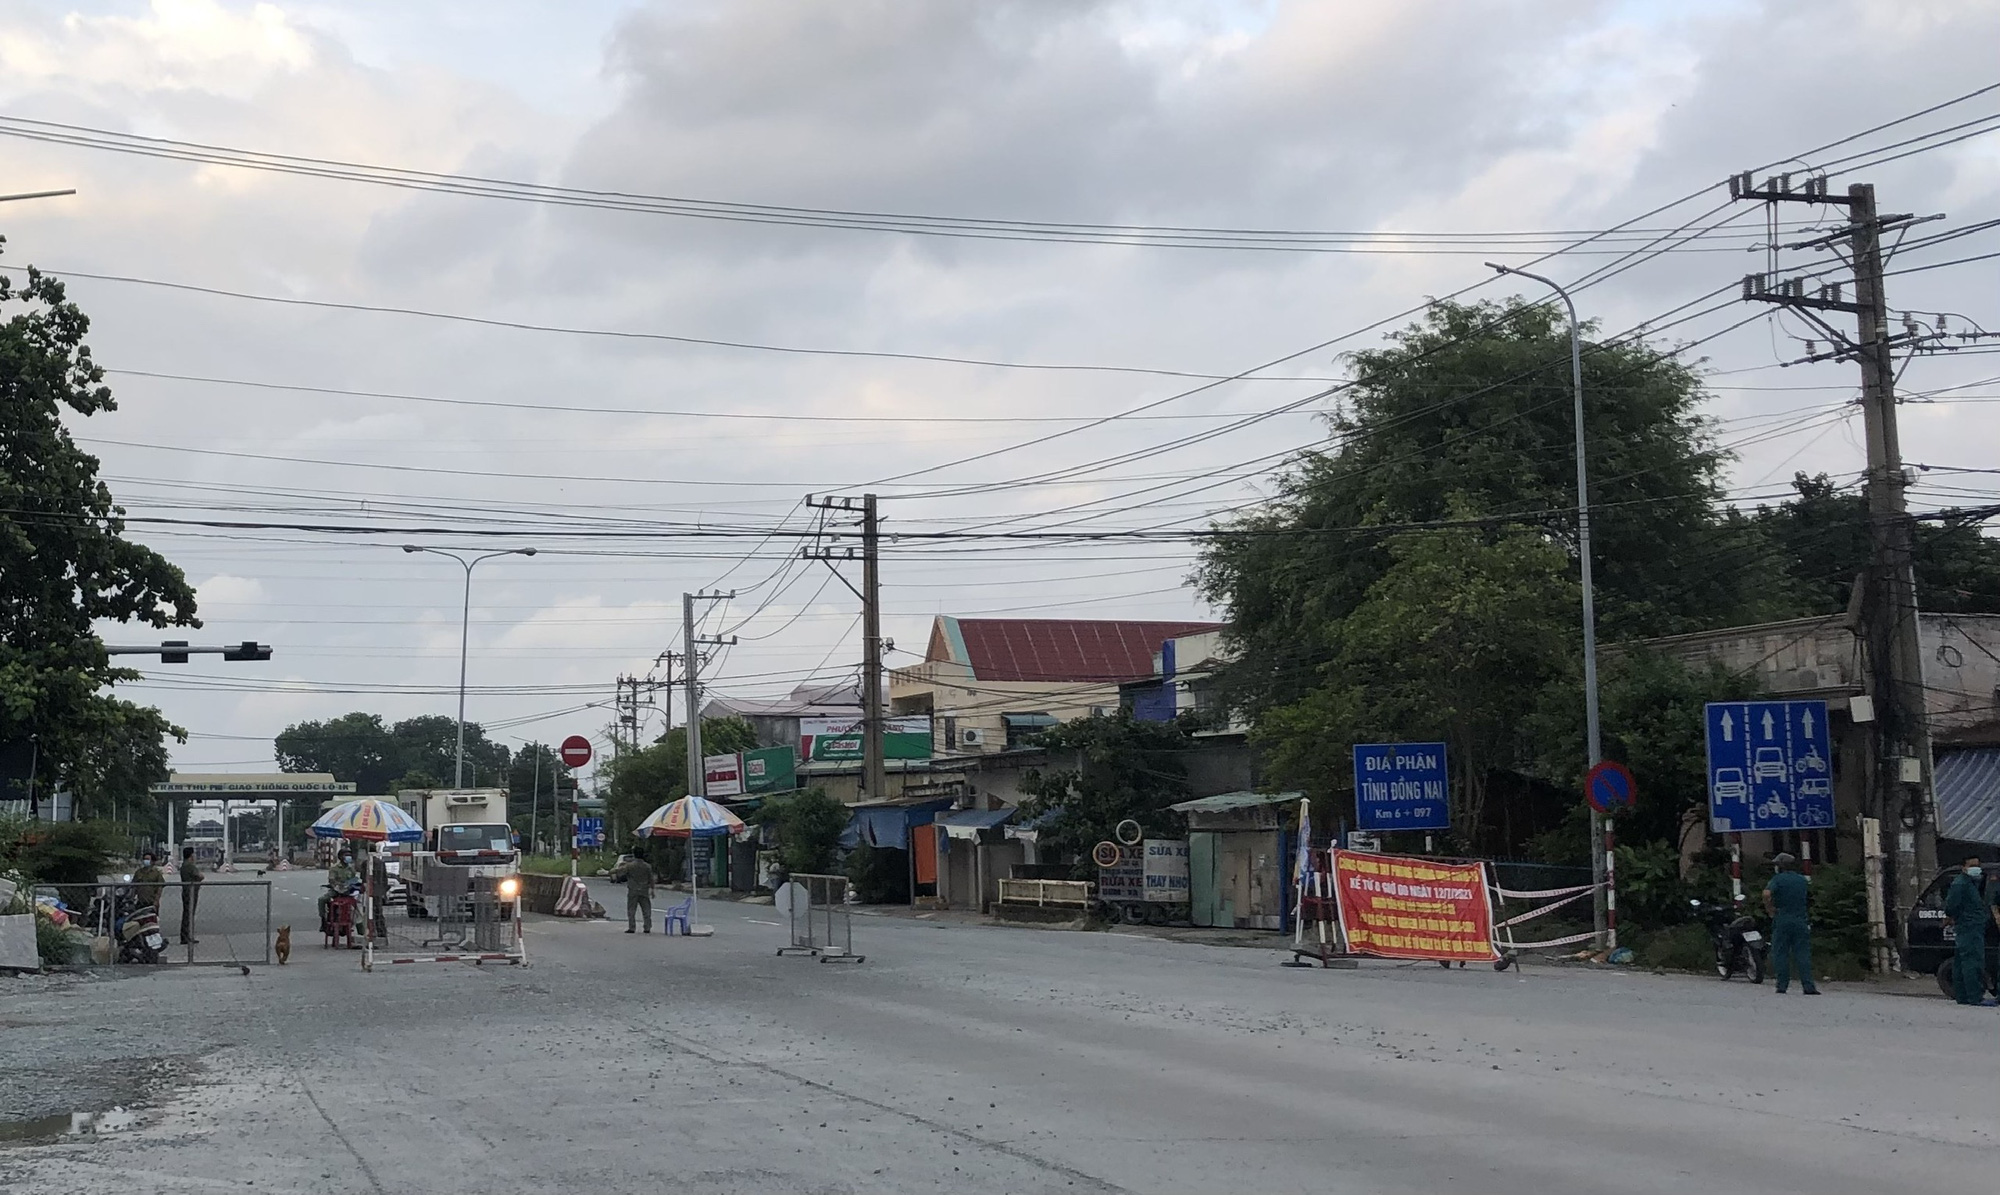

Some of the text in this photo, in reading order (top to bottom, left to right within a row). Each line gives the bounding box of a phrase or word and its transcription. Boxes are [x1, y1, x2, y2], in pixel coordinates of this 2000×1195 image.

[1396, 752, 1437, 772] PHẬN
[1361, 777, 1388, 801] TỈNH
[1424, 780, 1443, 799] NAI
[1375, 808, 1392, 819] Km
[1394, 808, 1401, 818] 6
[1409, 883, 1432, 898] NGÀY
